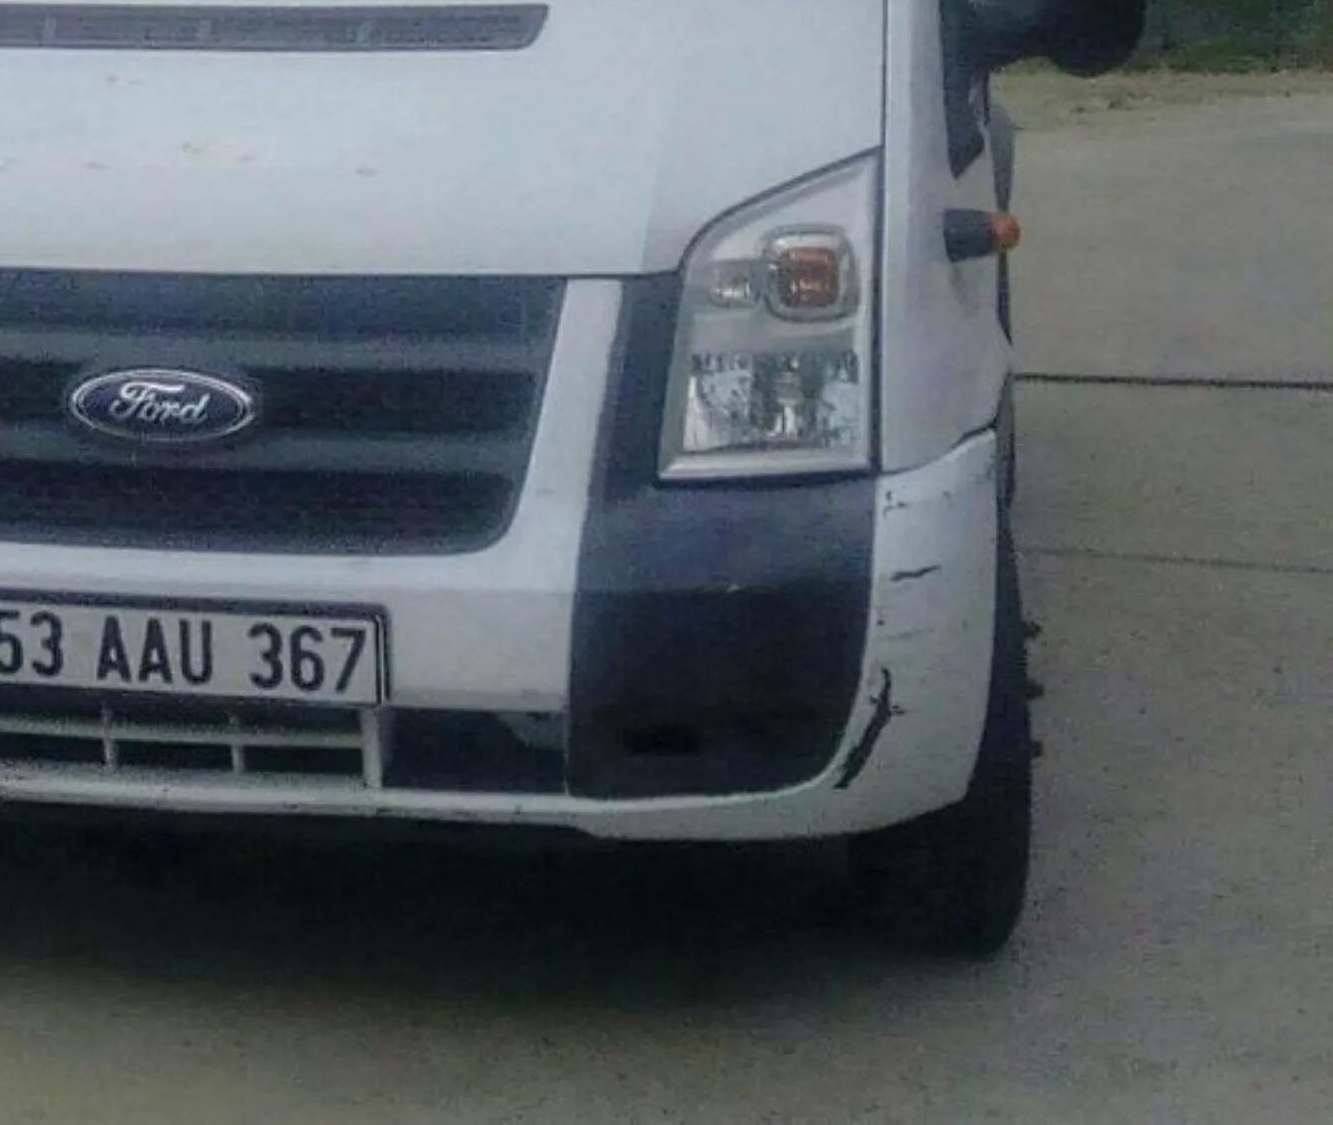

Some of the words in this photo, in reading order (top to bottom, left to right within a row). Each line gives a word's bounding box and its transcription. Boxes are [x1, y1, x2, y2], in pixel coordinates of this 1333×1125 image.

[109, 381, 210, 423] Ford
[96, 616, 213, 685] AAU
[248, 622, 367, 692] 367
